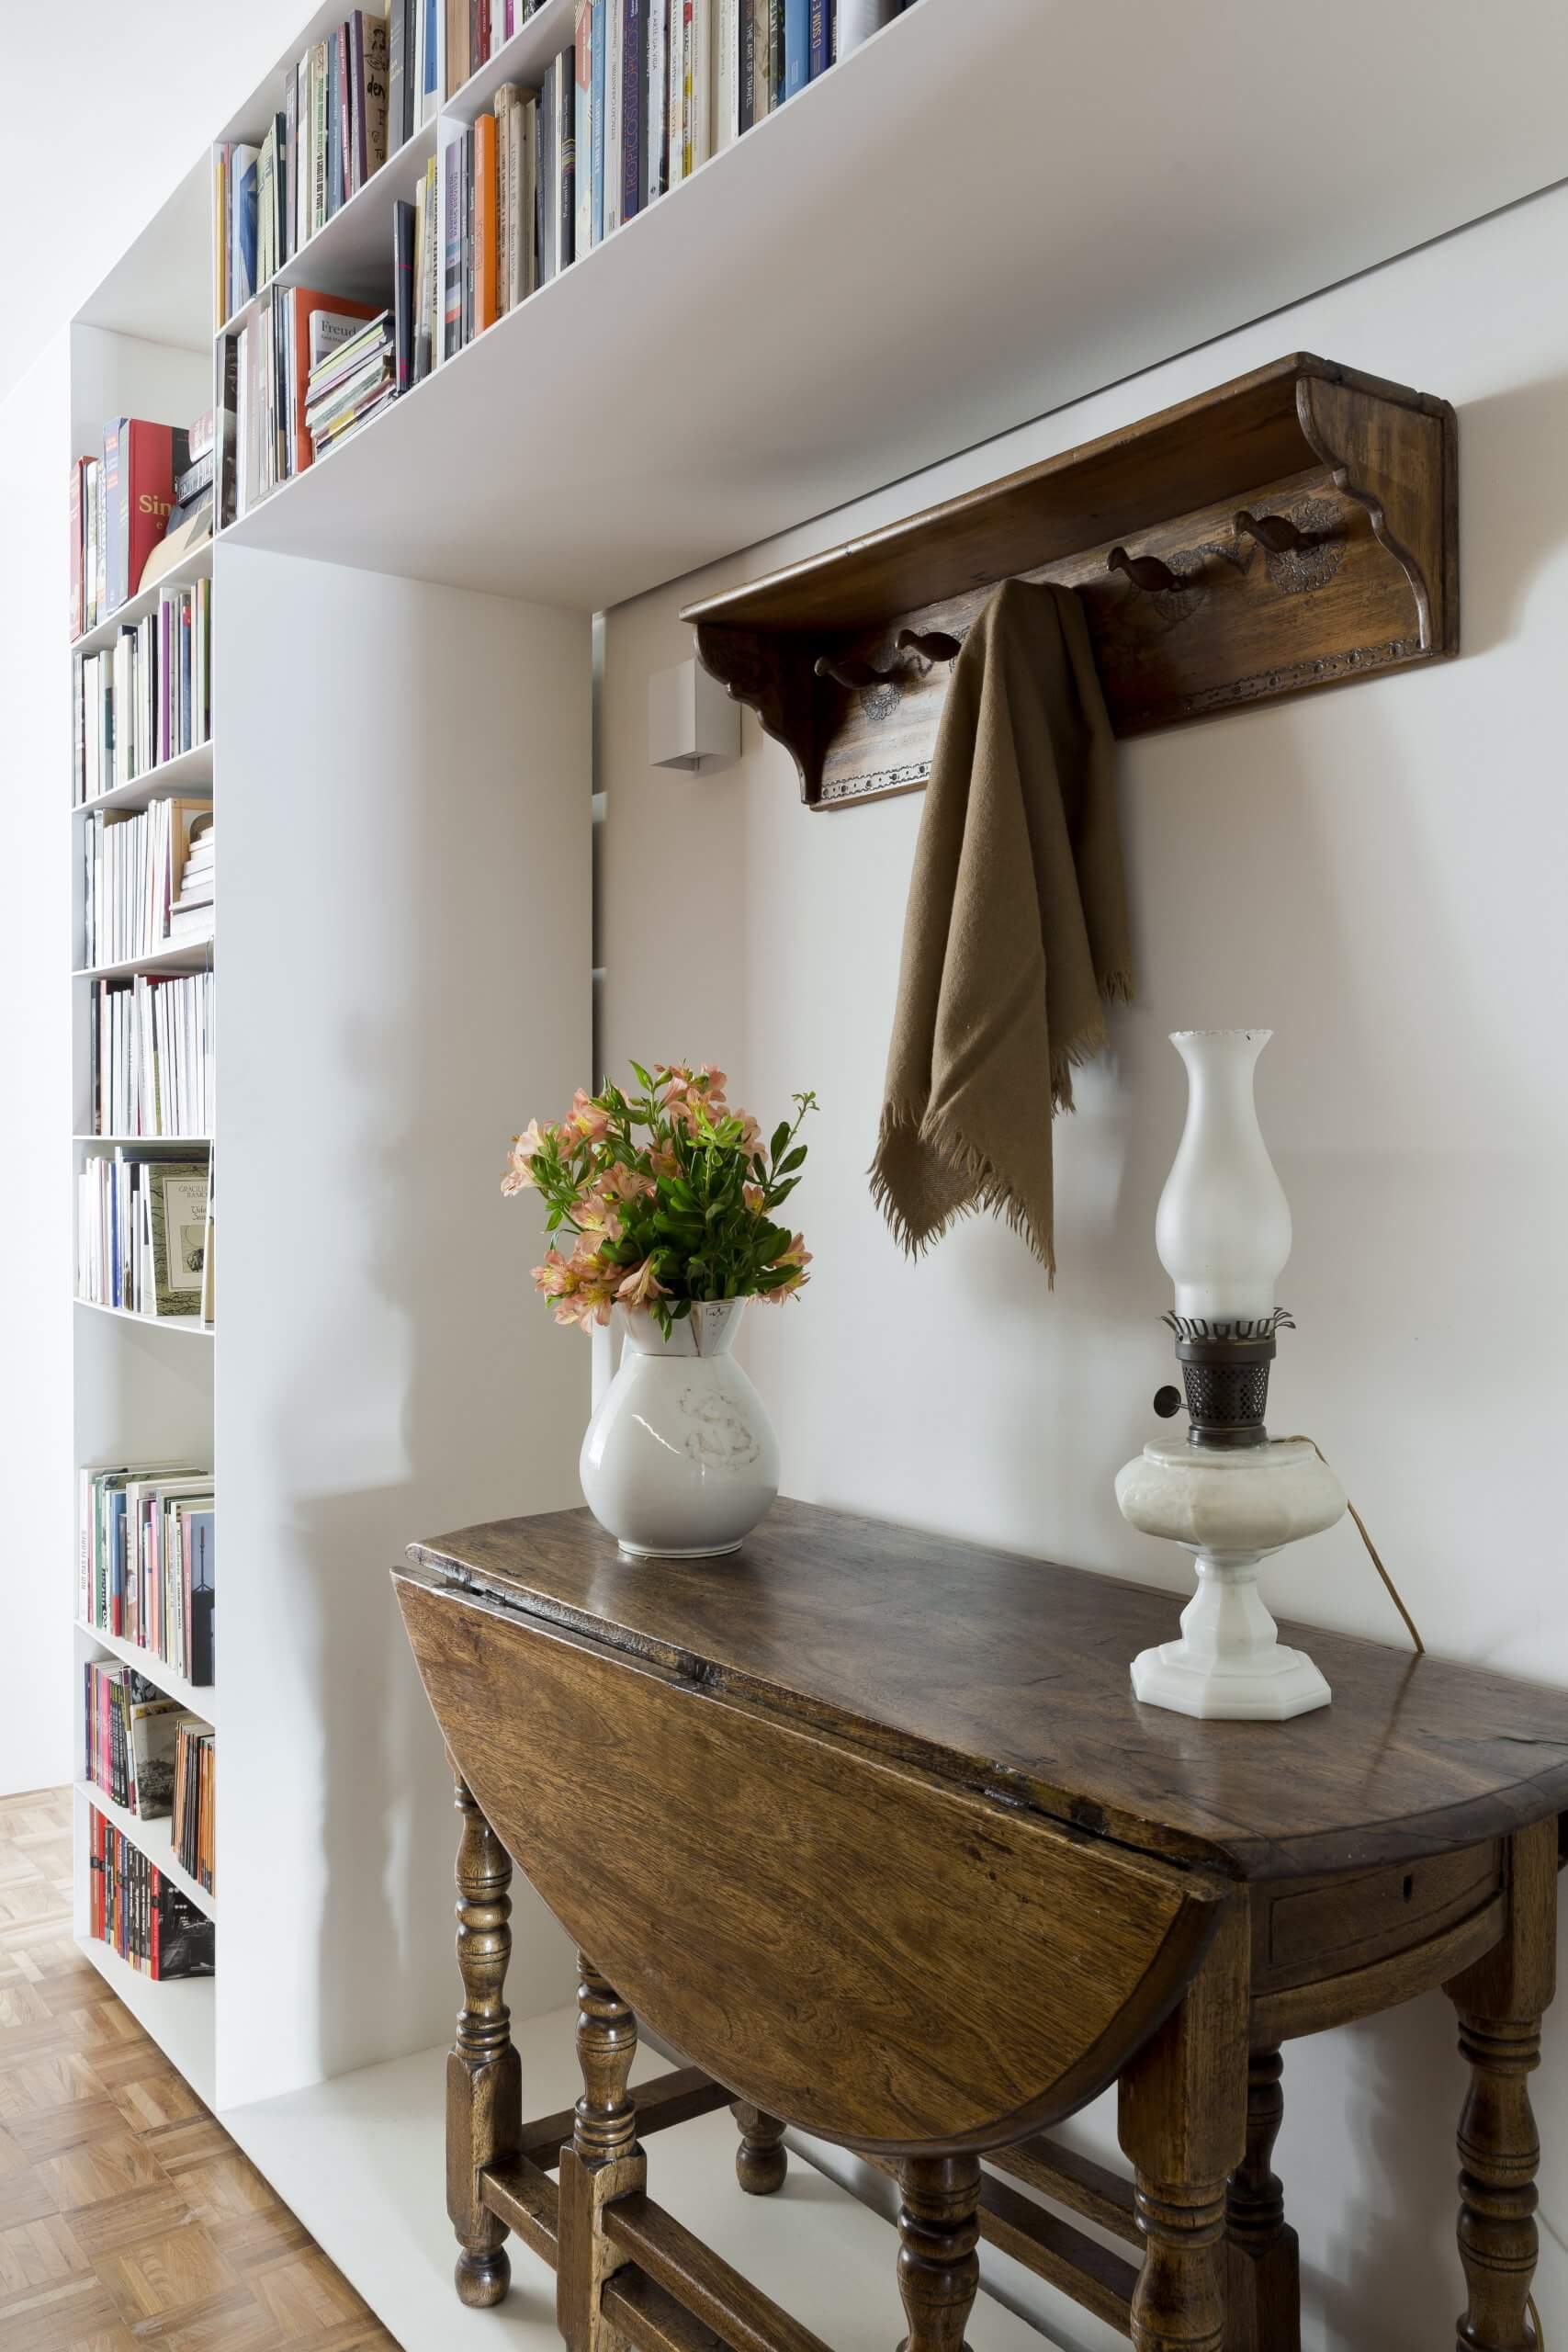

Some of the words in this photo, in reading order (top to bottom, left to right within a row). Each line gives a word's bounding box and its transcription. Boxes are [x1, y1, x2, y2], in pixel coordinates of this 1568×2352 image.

[812, 15, 822, 37] SOM
[746, 62, 753, 73] OF
[321, 321, 356, 336] Freud
